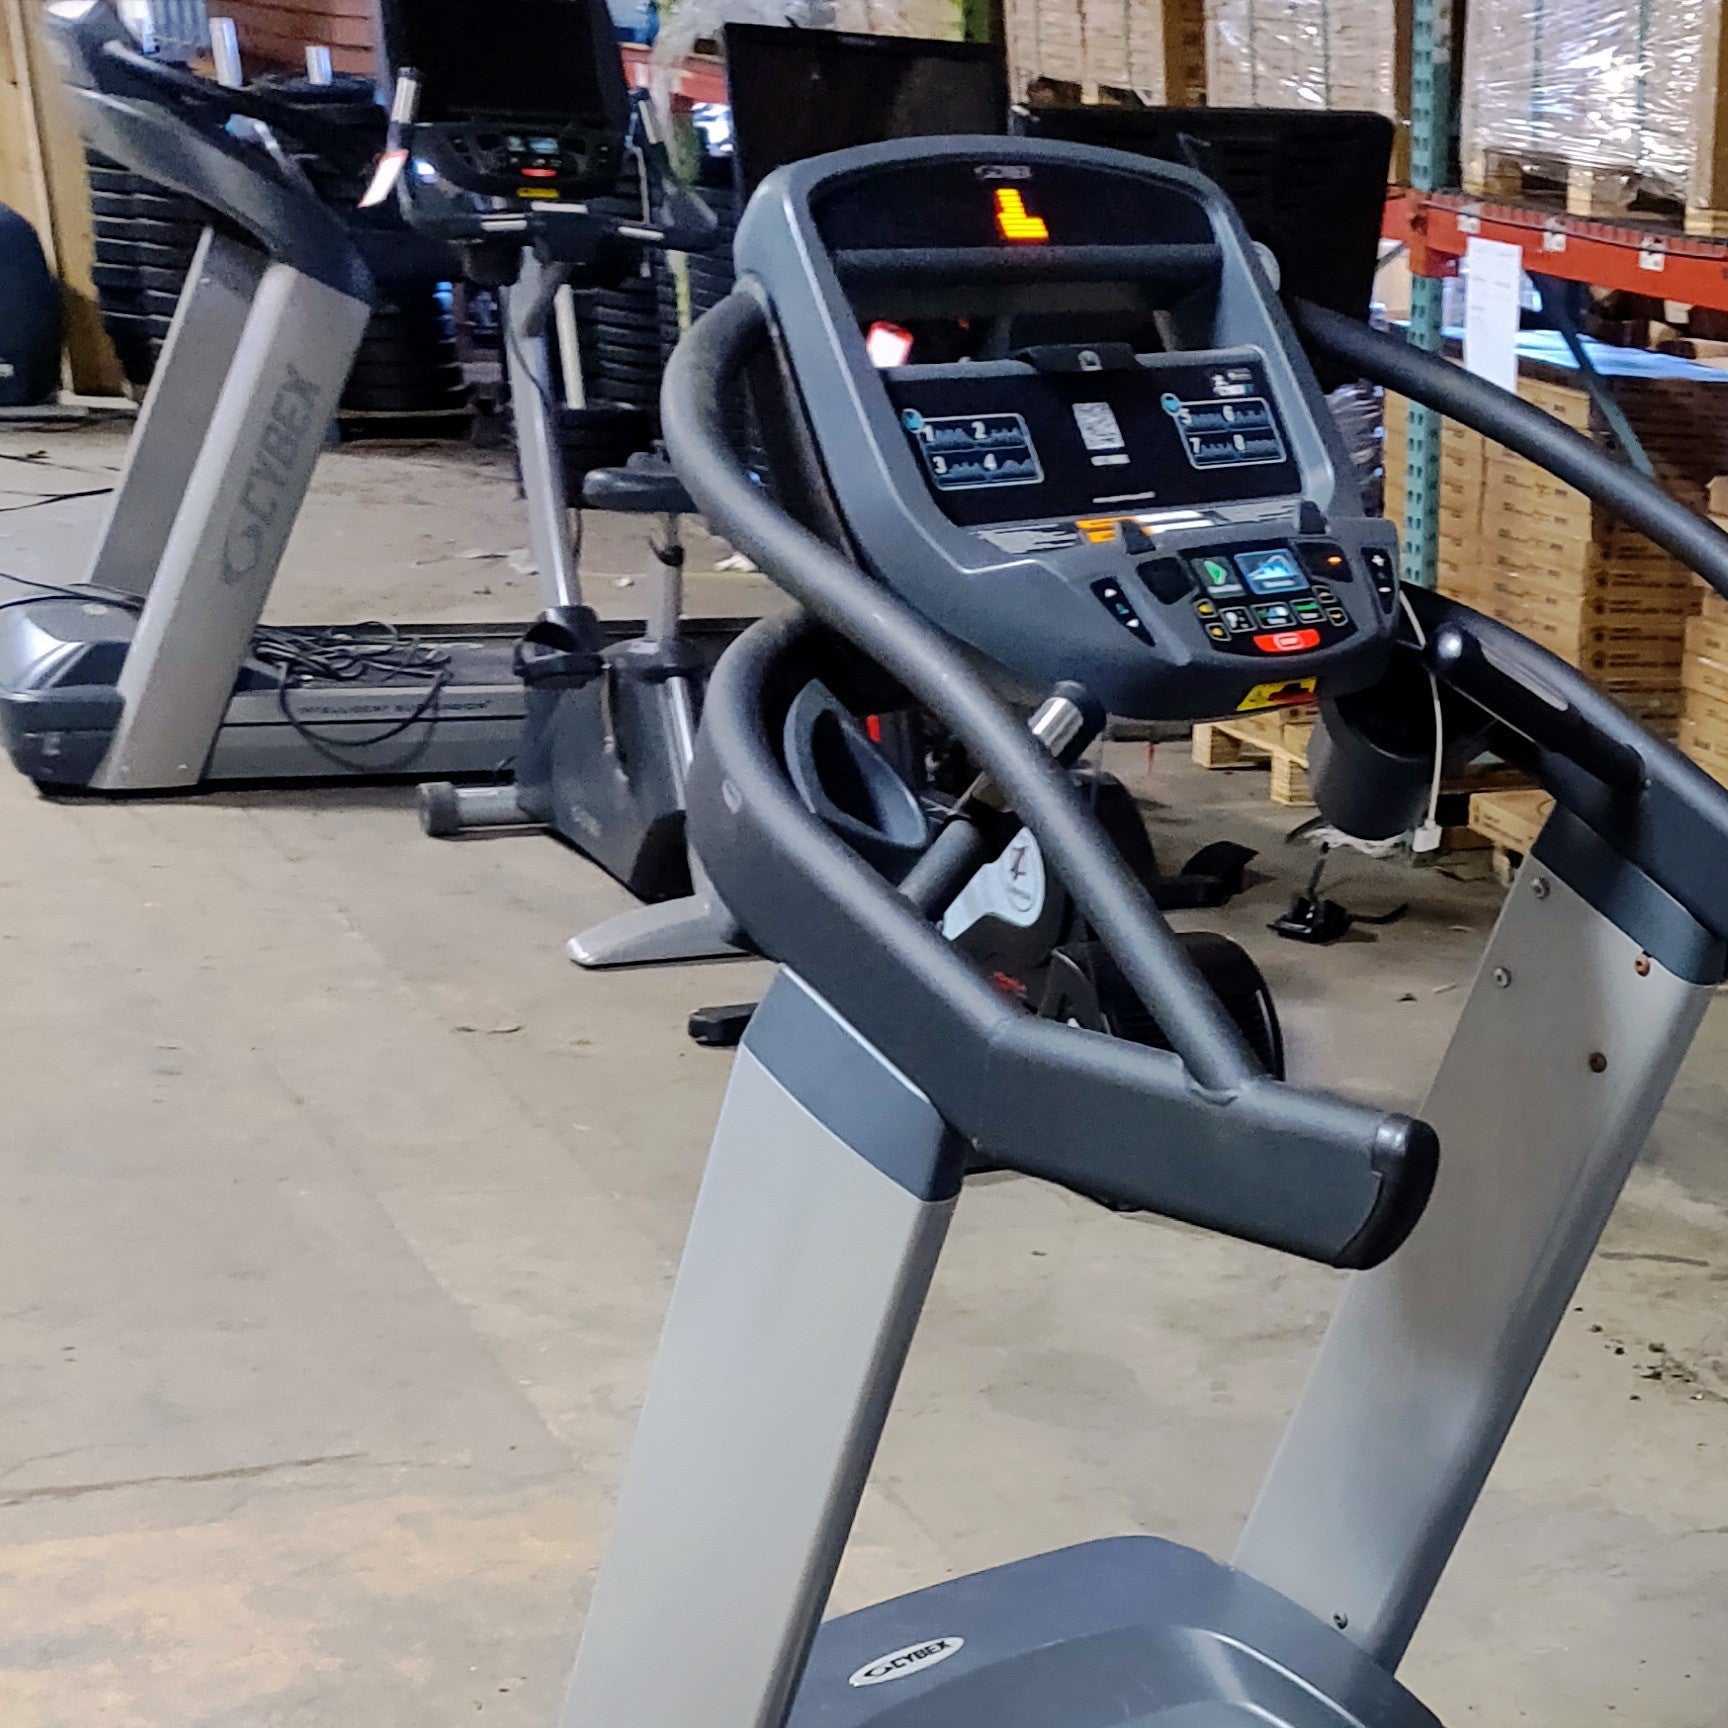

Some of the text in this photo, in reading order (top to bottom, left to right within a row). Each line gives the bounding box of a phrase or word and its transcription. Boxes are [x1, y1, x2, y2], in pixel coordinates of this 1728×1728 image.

[971, 421, 988, 439] 2
[1189, 436, 1201, 454] 7
[932, 456, 948, 474] 3
[890, 1640, 951, 1668] CYBEX
